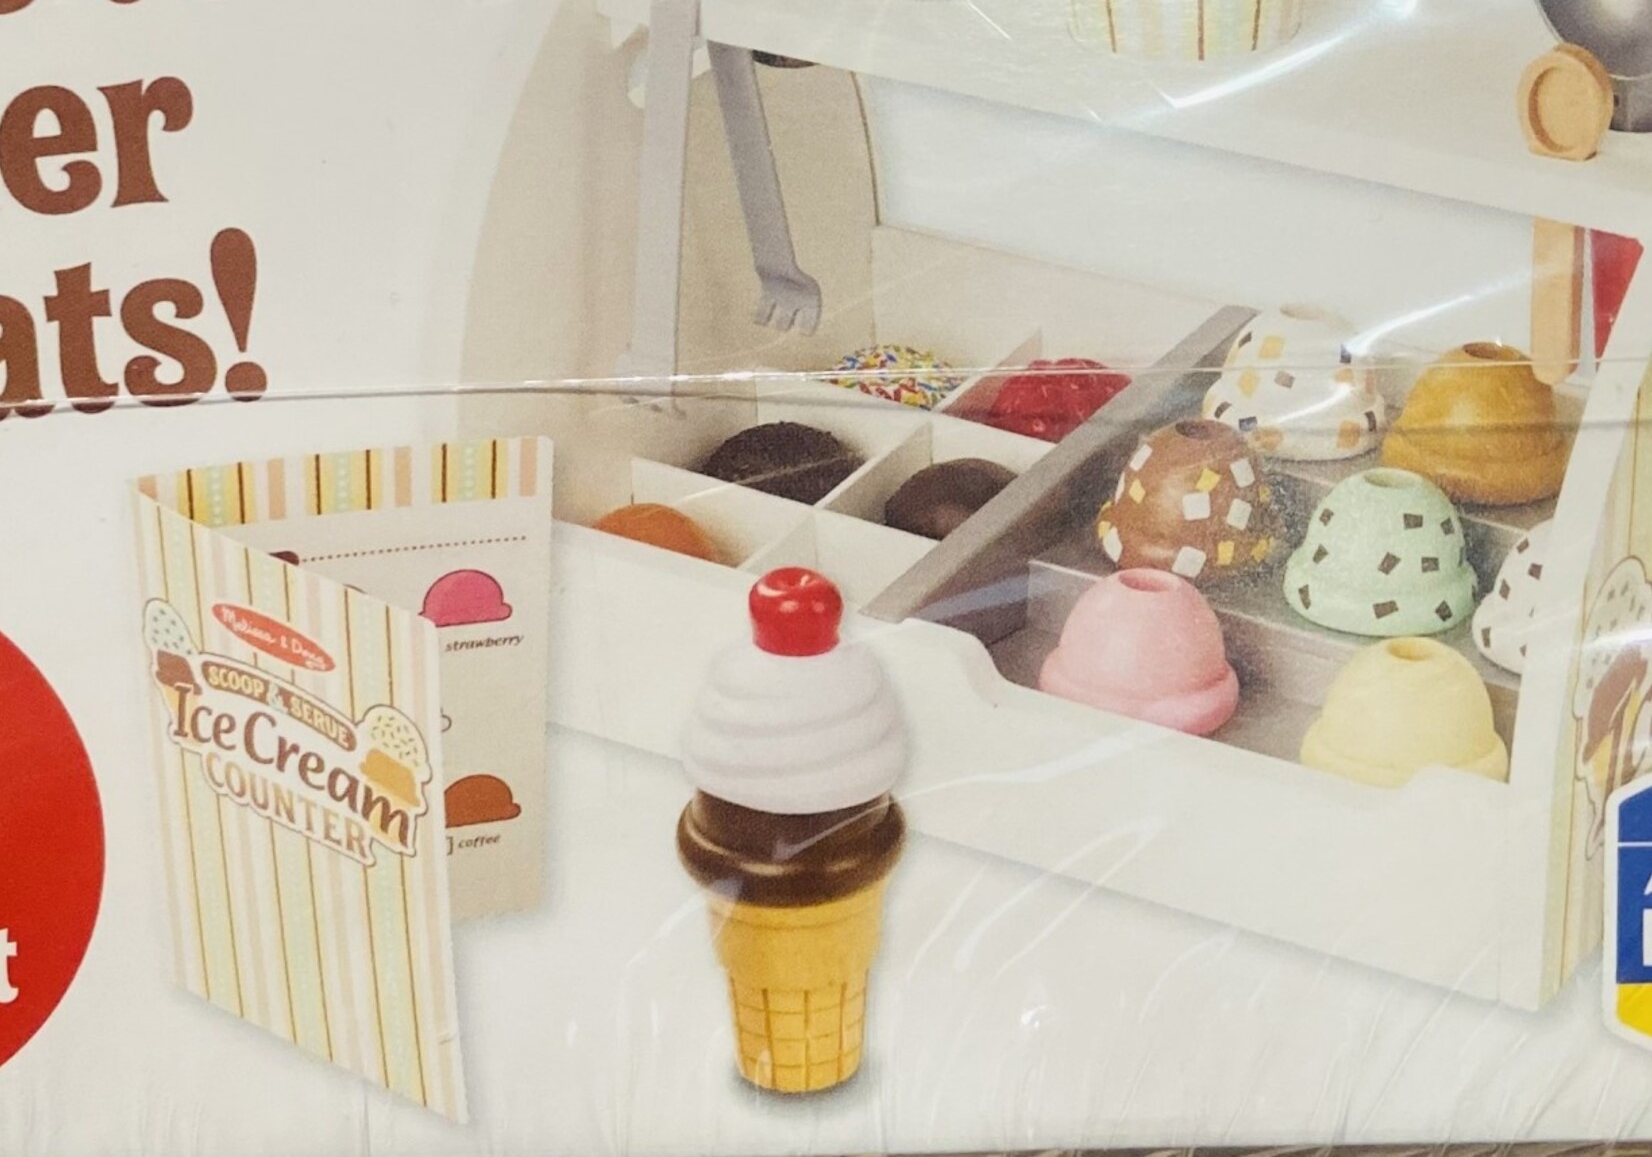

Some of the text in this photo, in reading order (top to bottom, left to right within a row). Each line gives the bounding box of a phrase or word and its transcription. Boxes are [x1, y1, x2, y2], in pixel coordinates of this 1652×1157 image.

[0, 76, 194, 216] er
[445, 635, 525, 652] strawberry
[207, 664, 265, 698] SCOOP
[267, 680, 289, 716] &
[173, 682, 410, 849] Ice Cream
[204, 751, 369, 859] COUNTER
[458, 834, 501, 849] coffee
